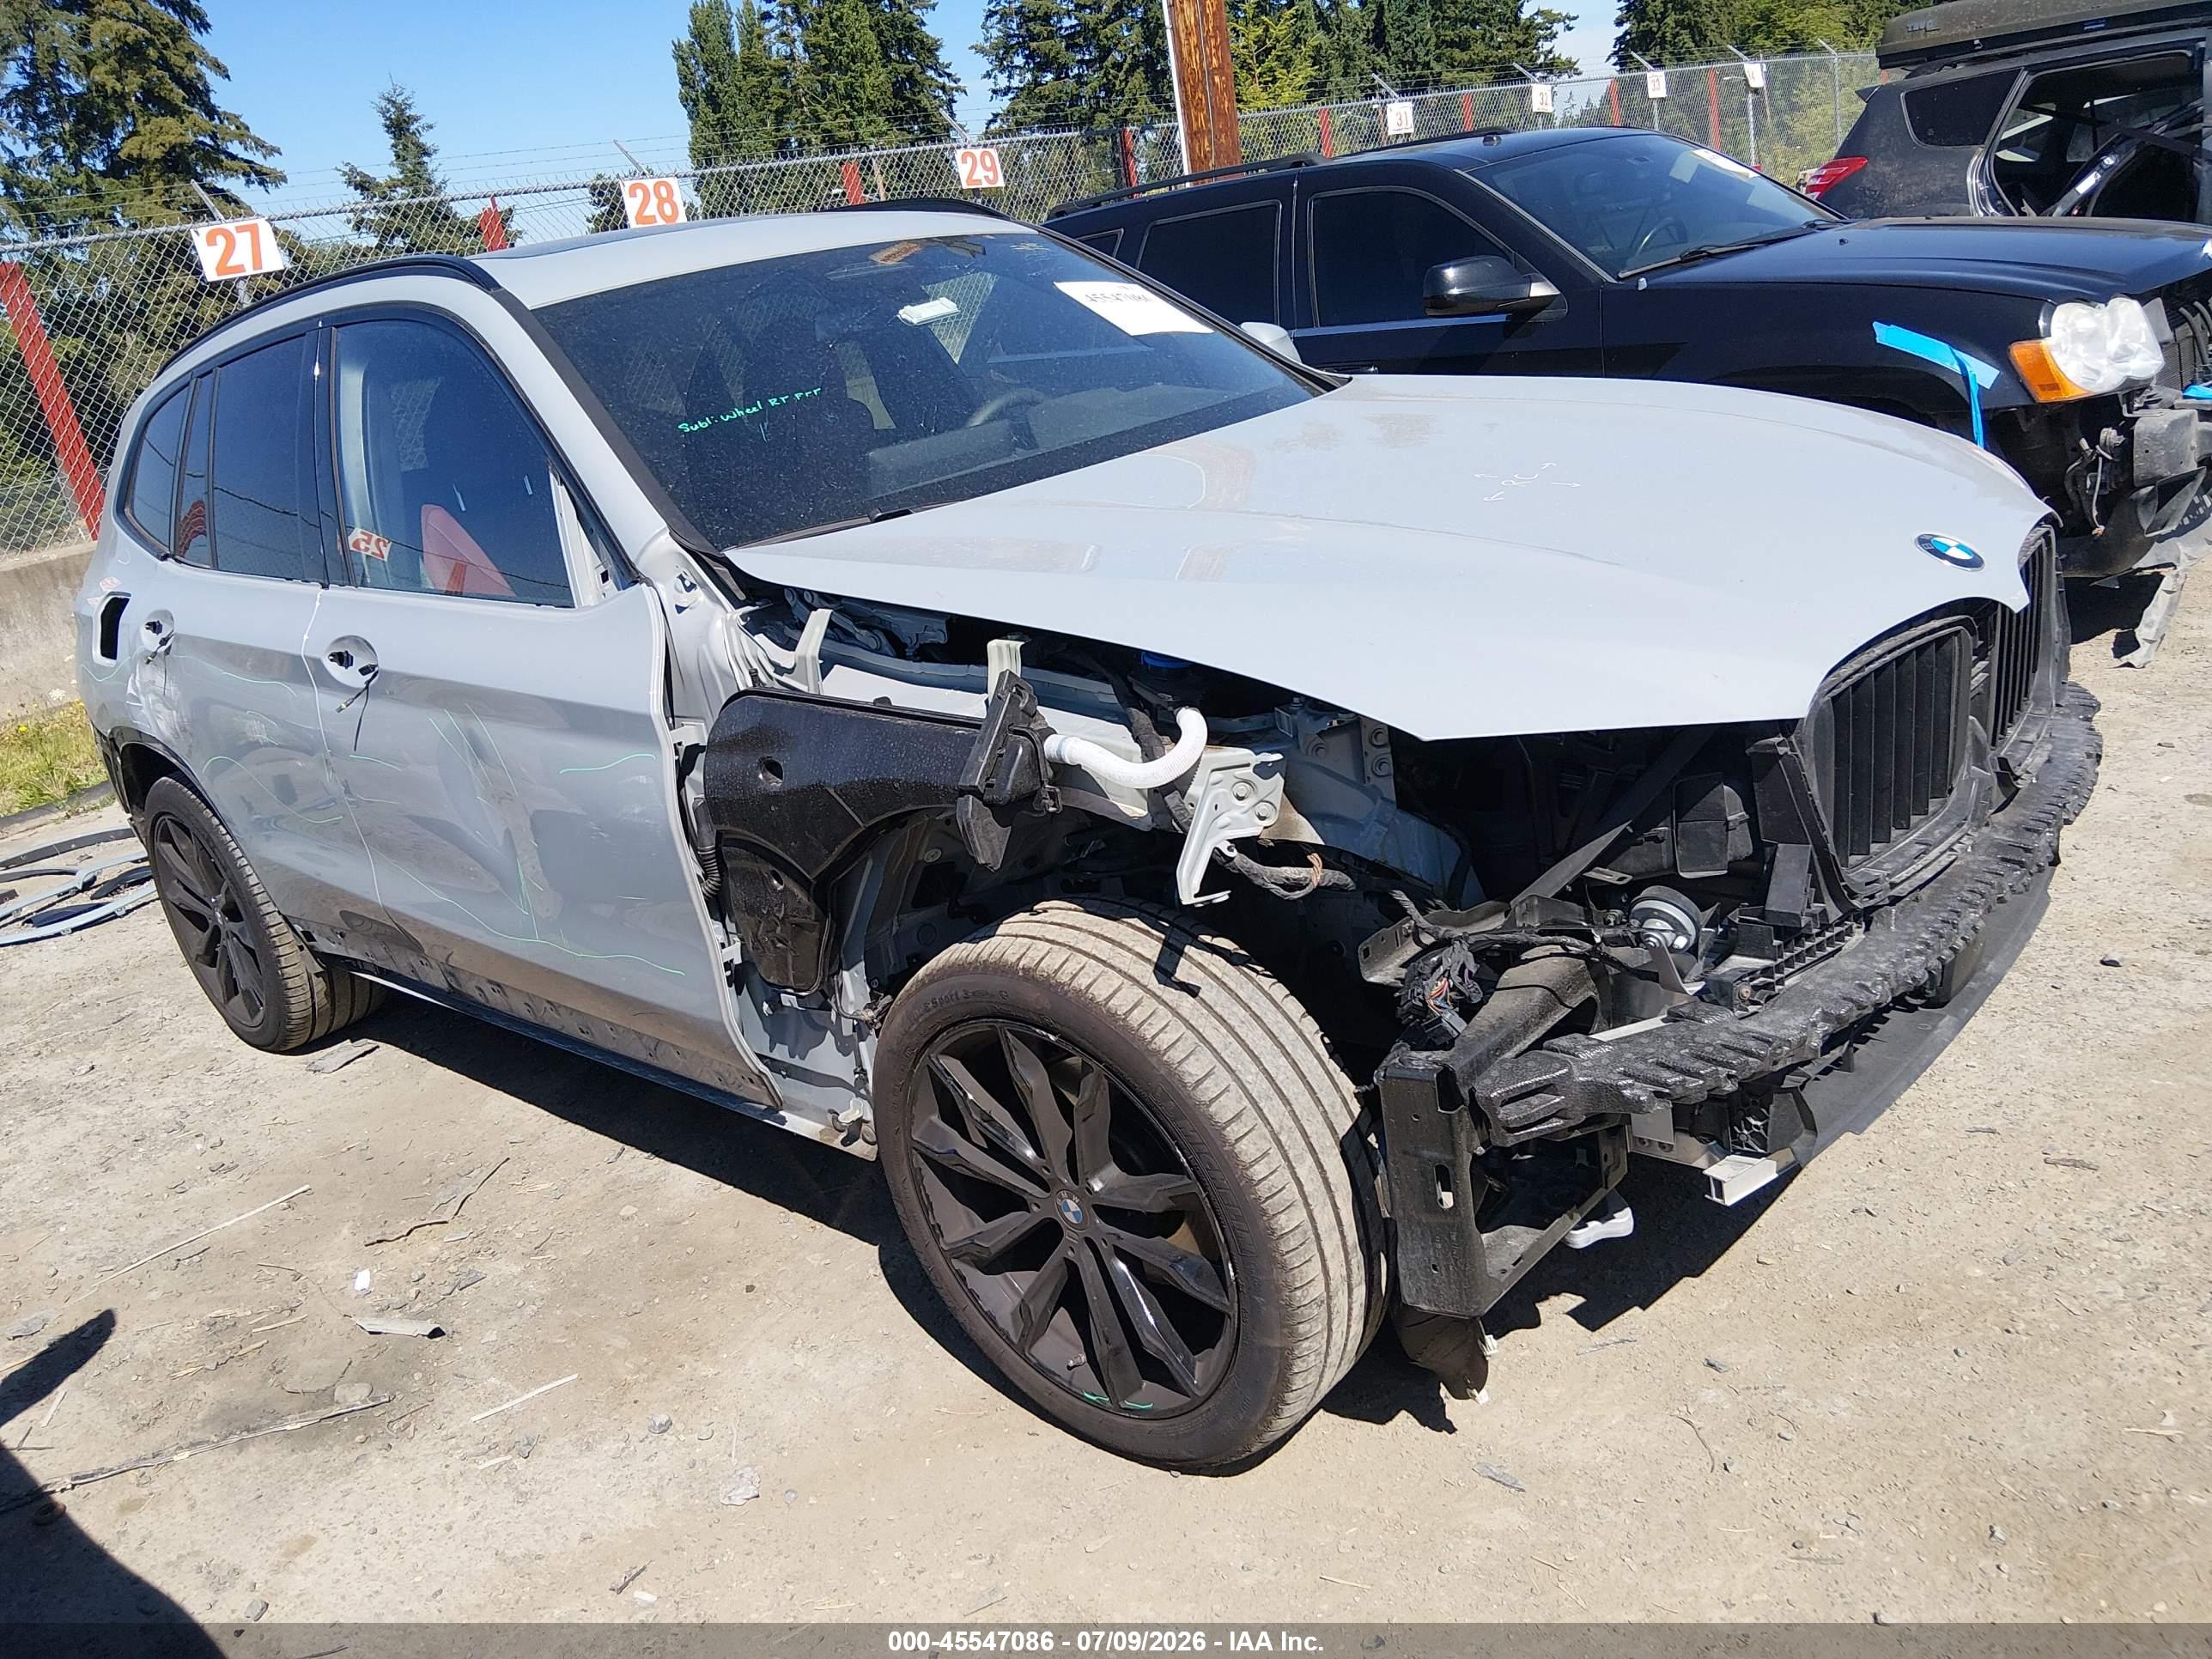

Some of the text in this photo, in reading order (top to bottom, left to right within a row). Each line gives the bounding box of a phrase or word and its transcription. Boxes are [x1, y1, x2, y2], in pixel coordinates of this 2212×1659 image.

[1539, 92, 1549, 106] 32
[1395, 111, 1408, 127] 31
[961, 150, 999, 185] 29
[629, 180, 679, 225] 28
[205, 222, 263, 276] 27
[768, 395, 789, 407] RT
